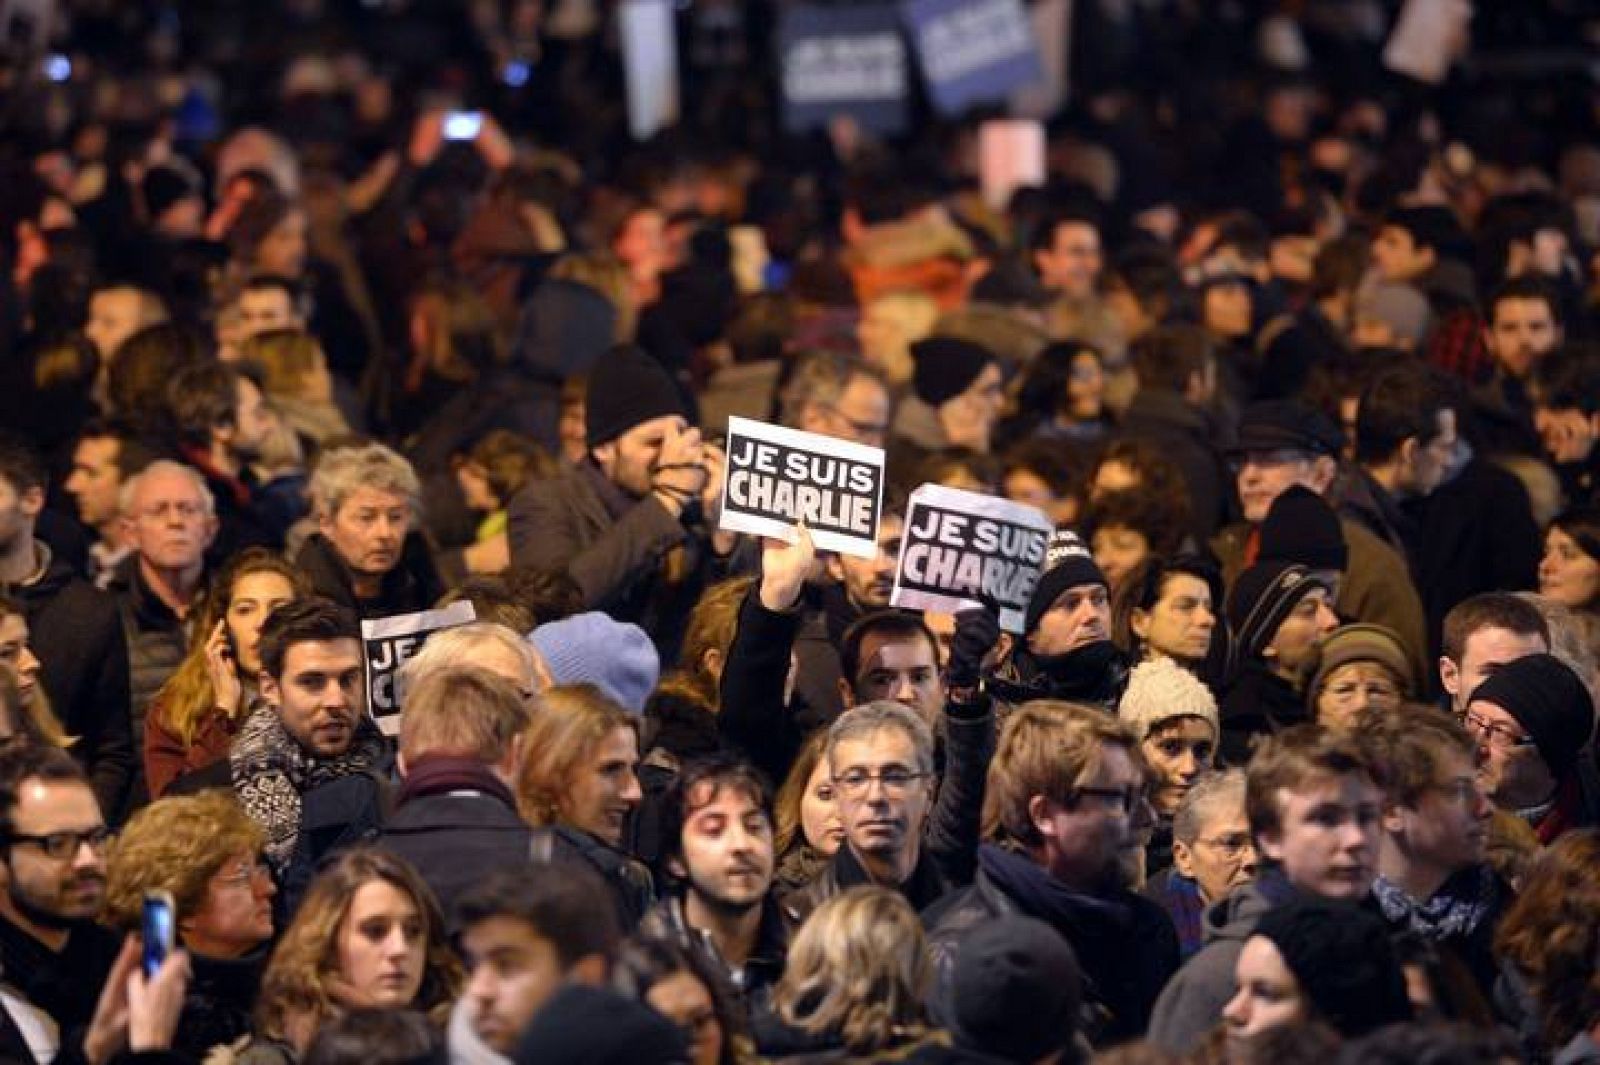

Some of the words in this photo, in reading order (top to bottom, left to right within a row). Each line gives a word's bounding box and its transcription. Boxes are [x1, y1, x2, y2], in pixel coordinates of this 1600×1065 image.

[732, 441, 779, 474] JE
[784, 452, 874, 492] SUIS
[729, 470, 873, 533] CHARLIE
[911, 510, 969, 547] JE
[972, 519, 1045, 564] SUIS
